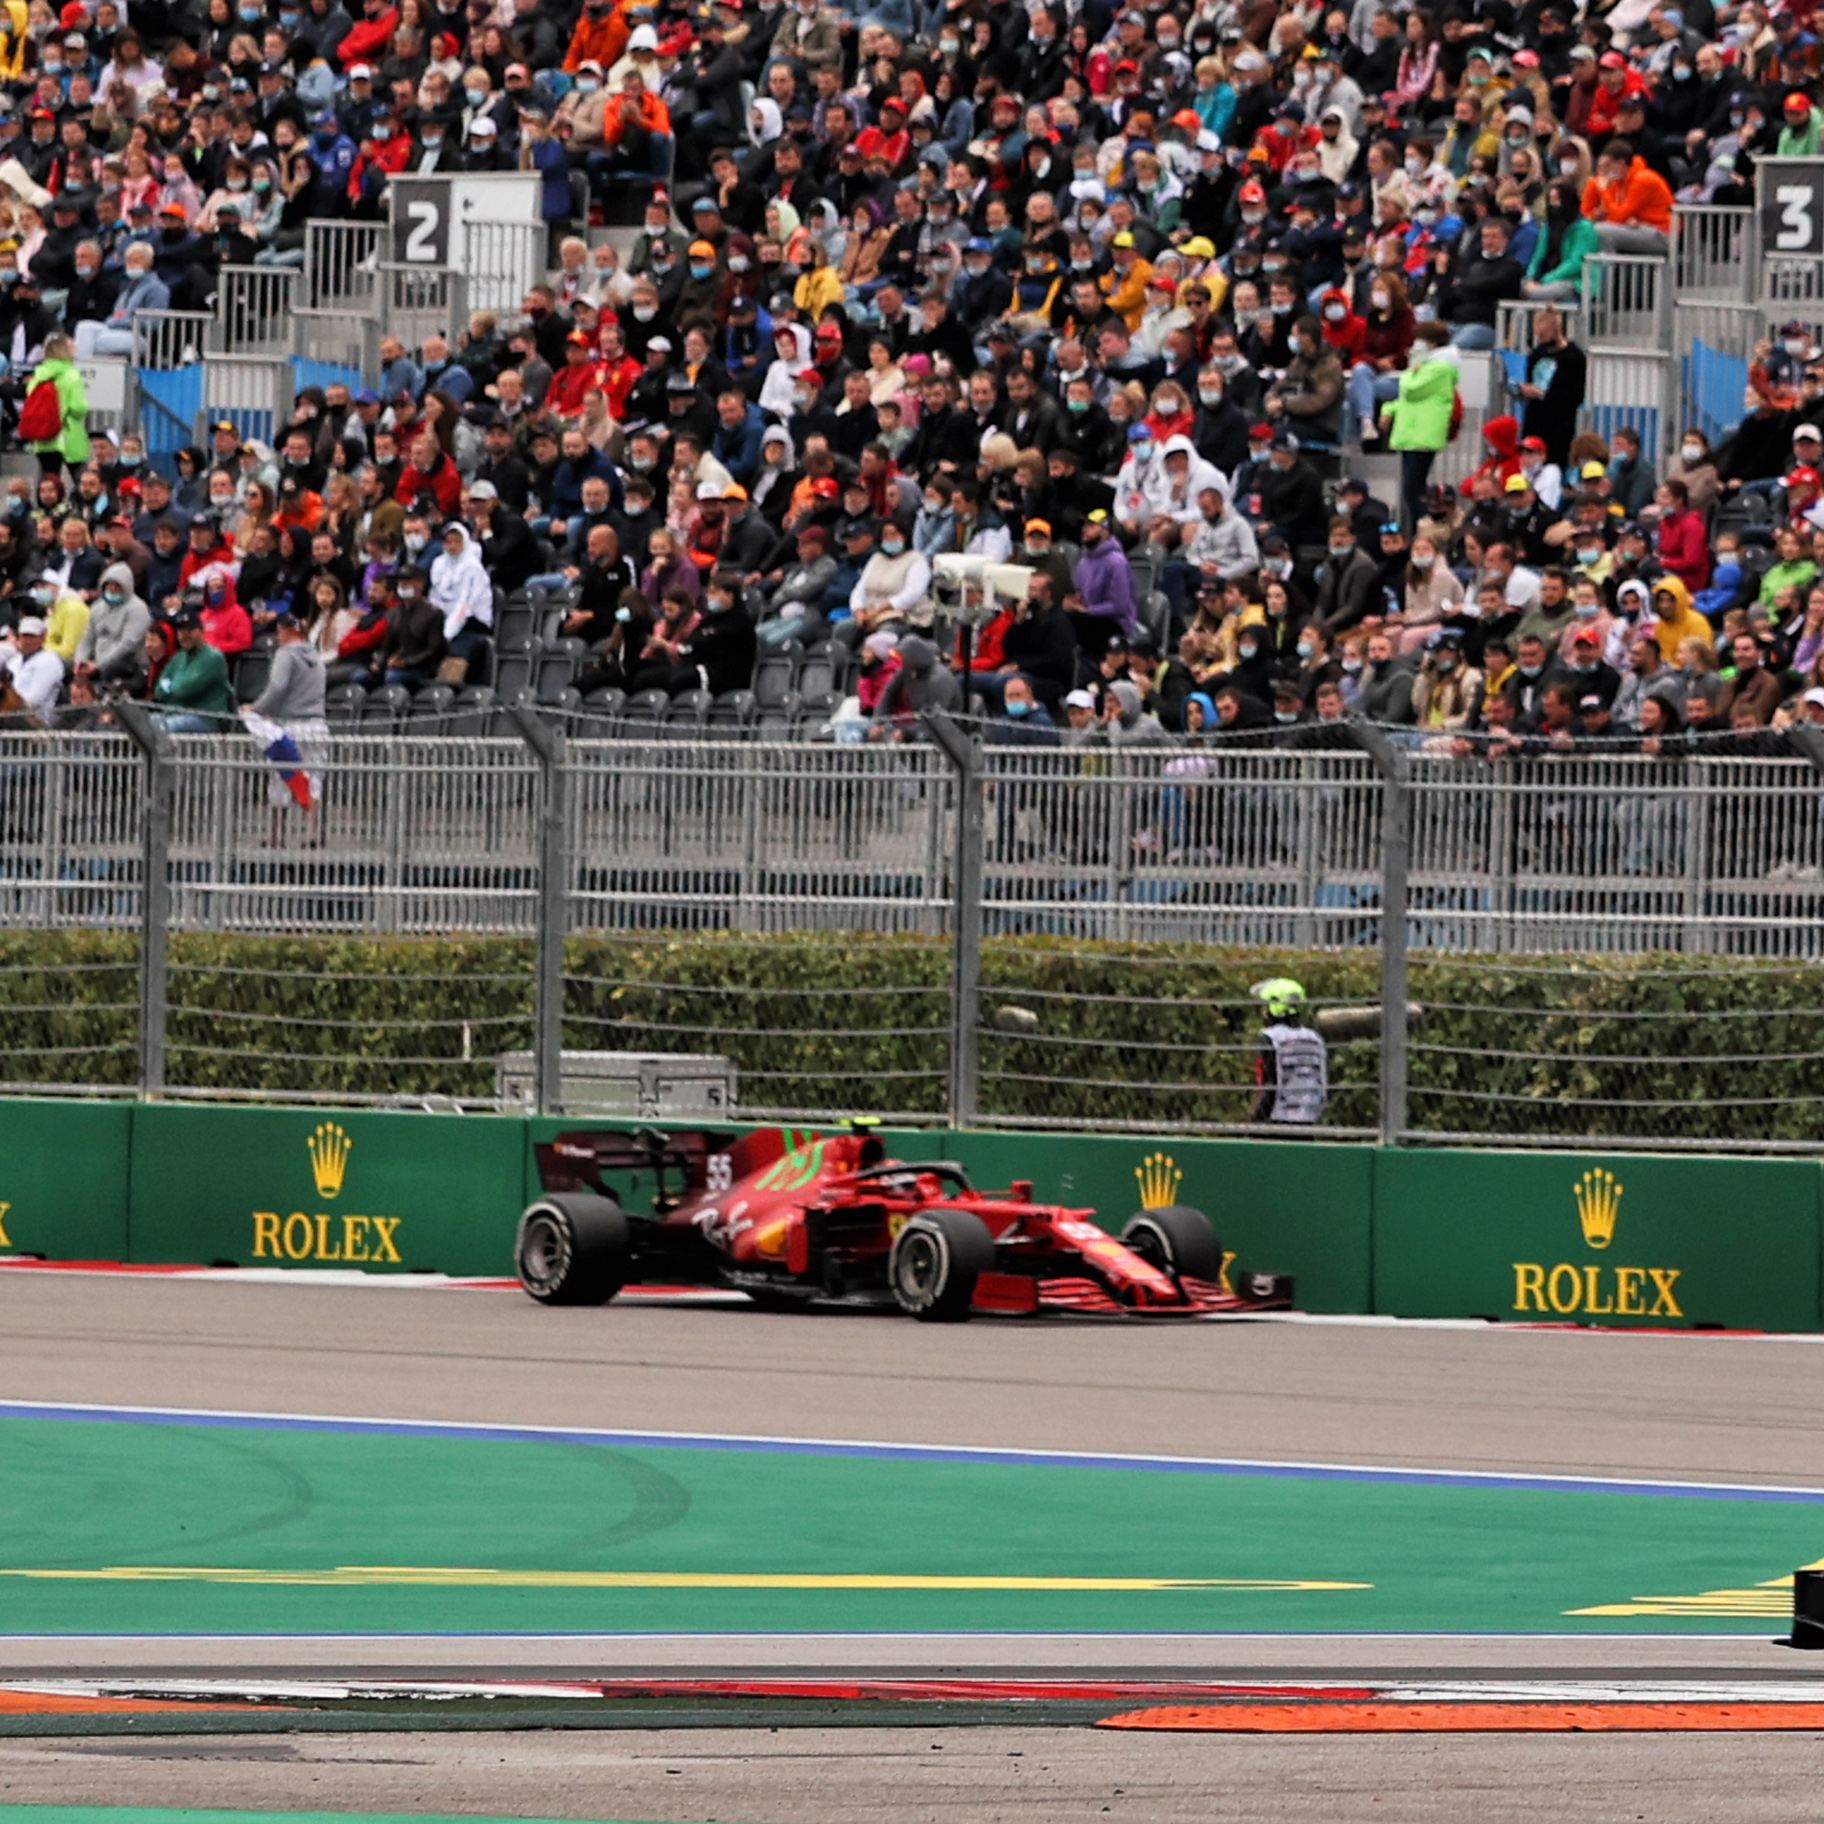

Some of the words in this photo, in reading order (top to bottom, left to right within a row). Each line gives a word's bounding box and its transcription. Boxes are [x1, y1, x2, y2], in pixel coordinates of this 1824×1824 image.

[406, 200, 439, 261] 2
[1776, 185, 1813, 249] 3
[706, 1154, 733, 1190] 55
[252, 1212, 402, 1263] ROLEX
[1514, 1263, 1682, 1317] ROLEX
